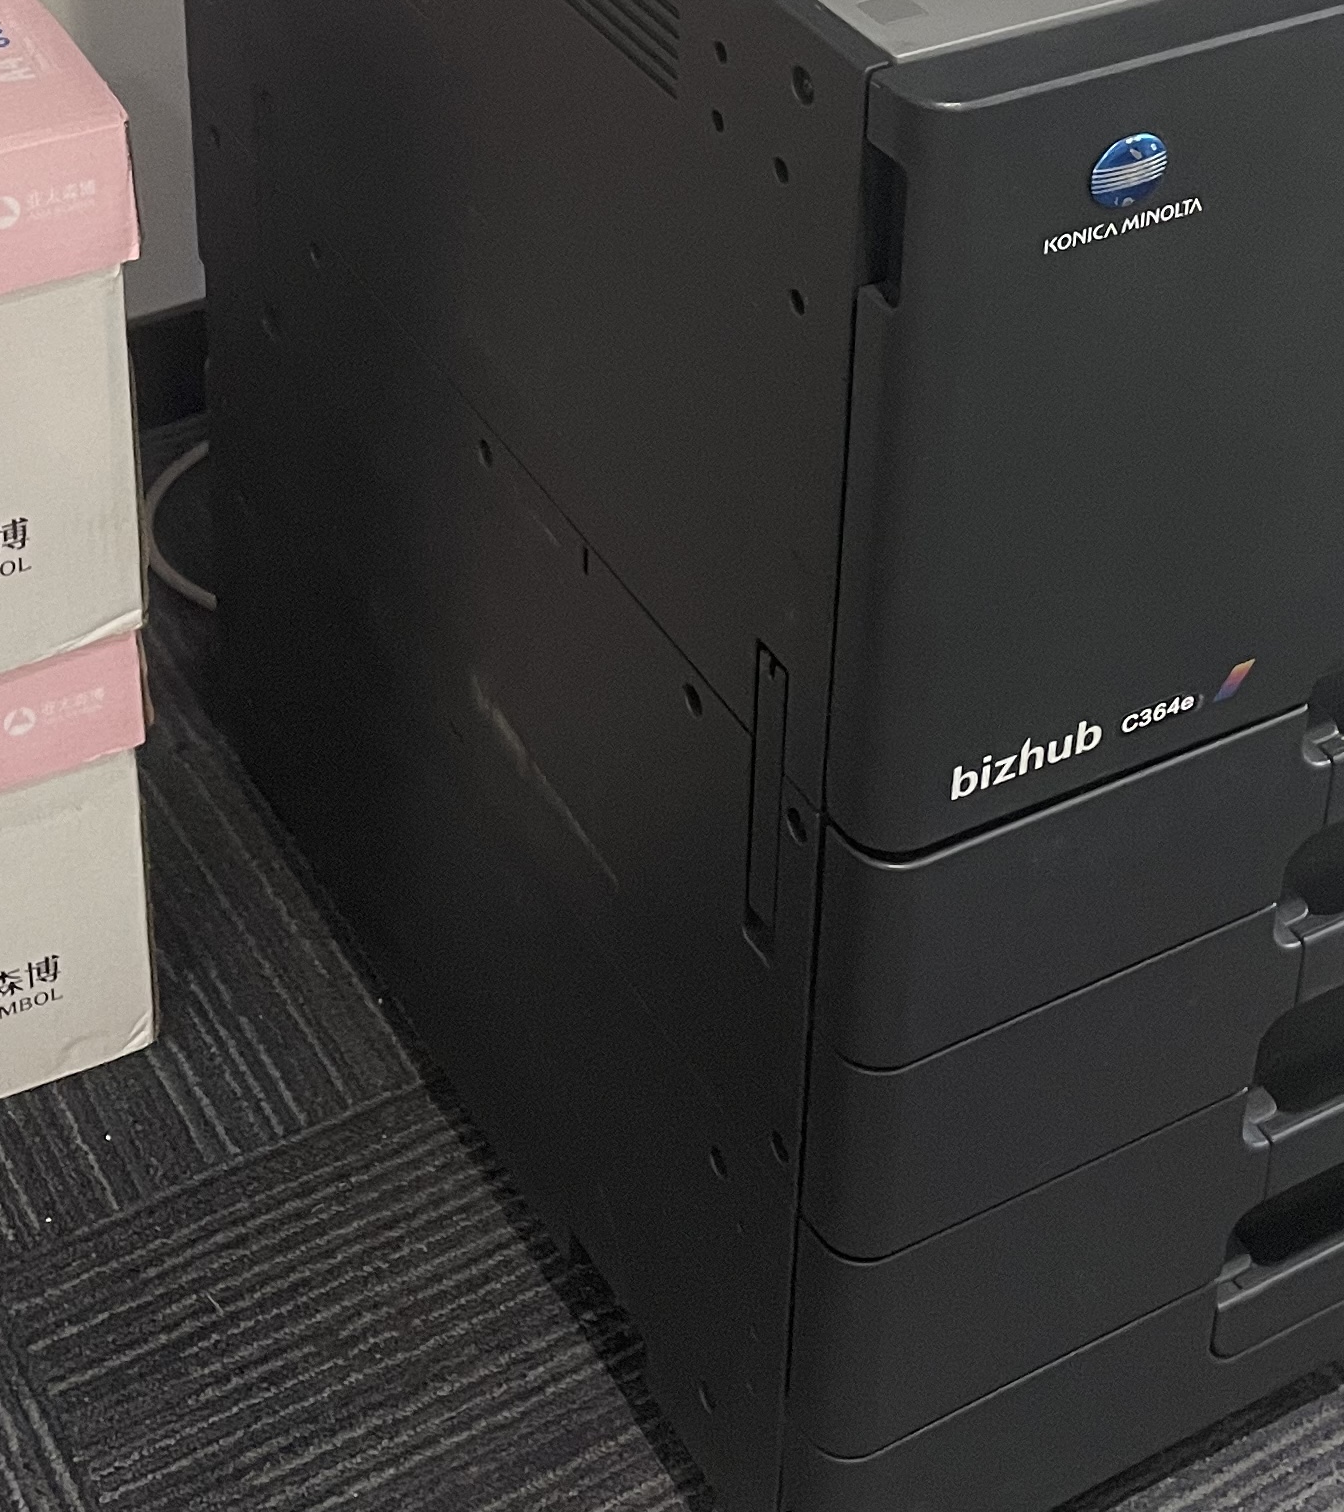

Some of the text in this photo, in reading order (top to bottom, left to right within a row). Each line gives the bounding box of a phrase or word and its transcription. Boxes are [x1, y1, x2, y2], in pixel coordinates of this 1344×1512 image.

[1043, 196, 1203, 256] KONICA MINOLTA
[950, 694, 1195, 801] bizhub C364e
